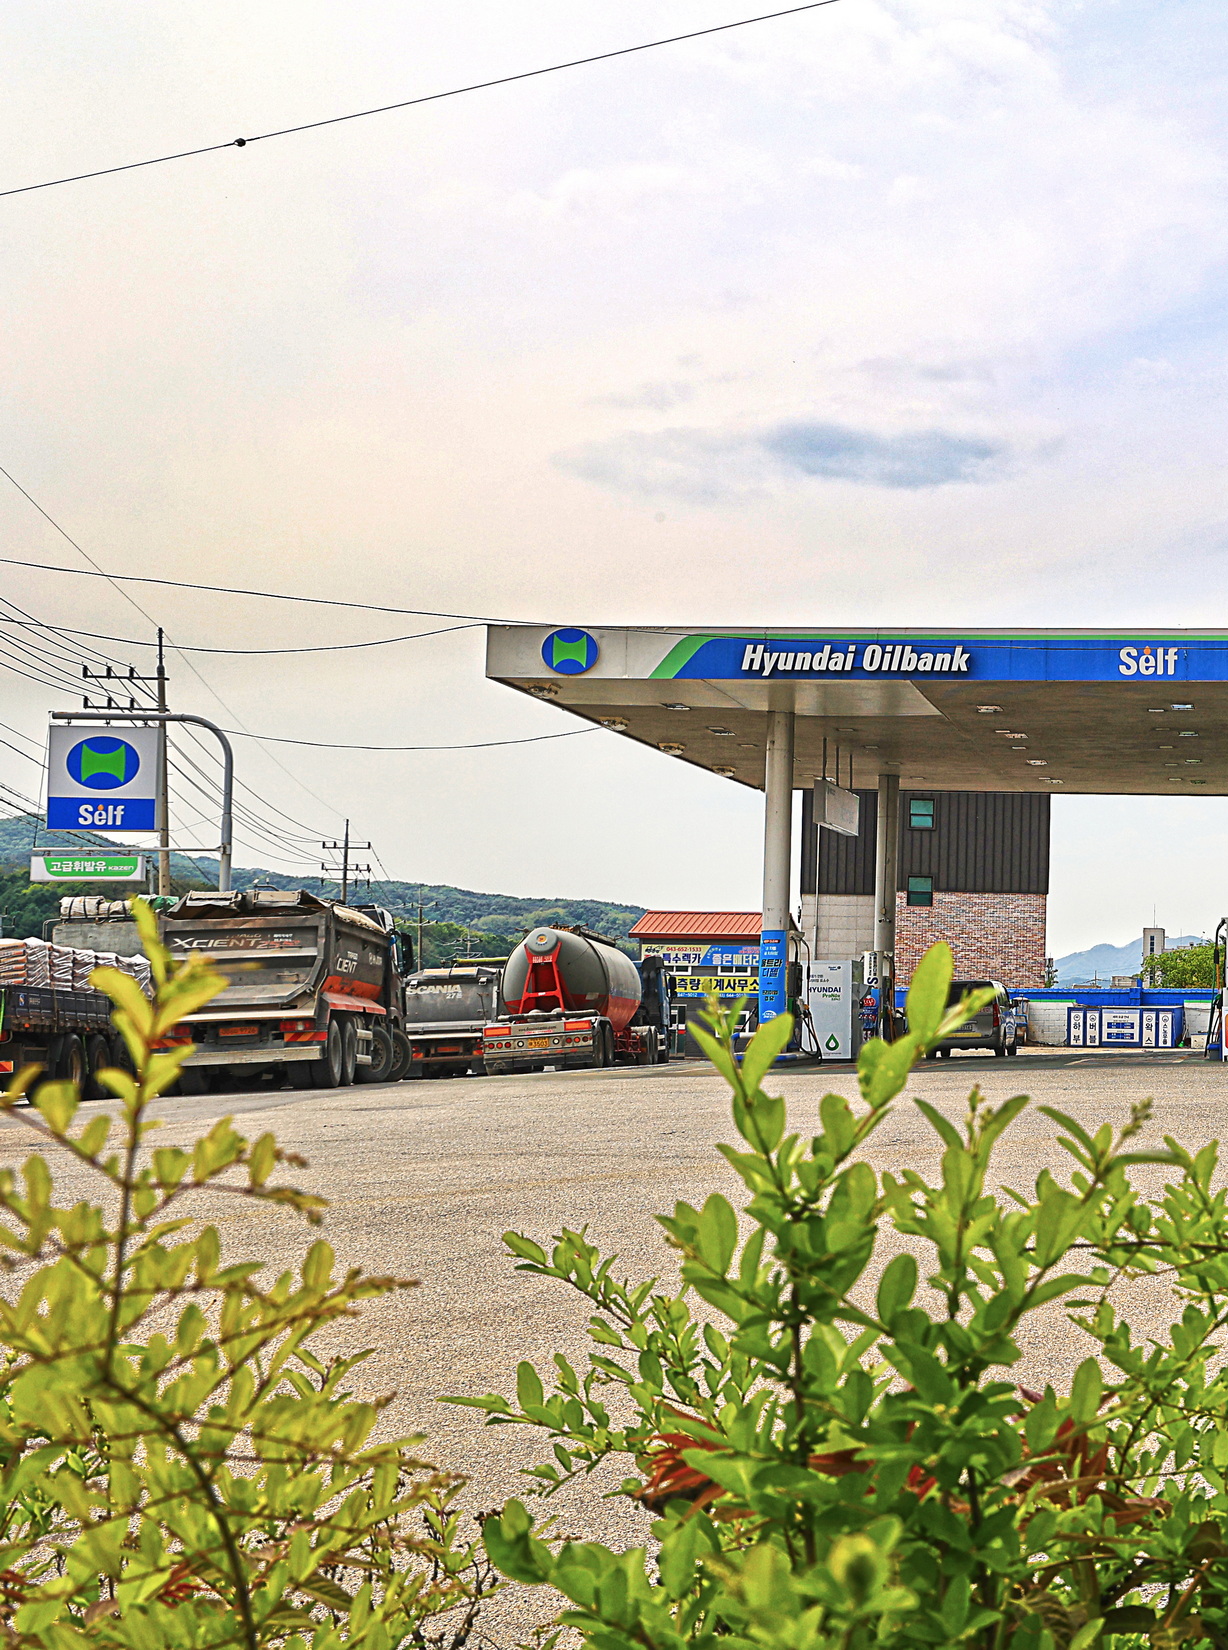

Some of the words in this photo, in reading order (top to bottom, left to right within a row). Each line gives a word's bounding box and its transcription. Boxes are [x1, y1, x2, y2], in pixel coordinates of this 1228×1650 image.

[741, 644, 856, 677] Hyundai
[862, 644, 971, 673] Oilbank
[1118, 646, 1178, 675] Self
[78, 804, 125, 825] Self
[50, 861, 106, 872] 고급휘발유
[169, 938, 262, 948] XCIENT
[406, 984, 462, 996] SCANIA
[677, 978, 759, 991] 측량계사무소
[1073, 1023, 1080, 1043] 하부
[1089, 1023, 1096, 1044] 버블
[1145, 1023, 1153, 1044] 왁스
